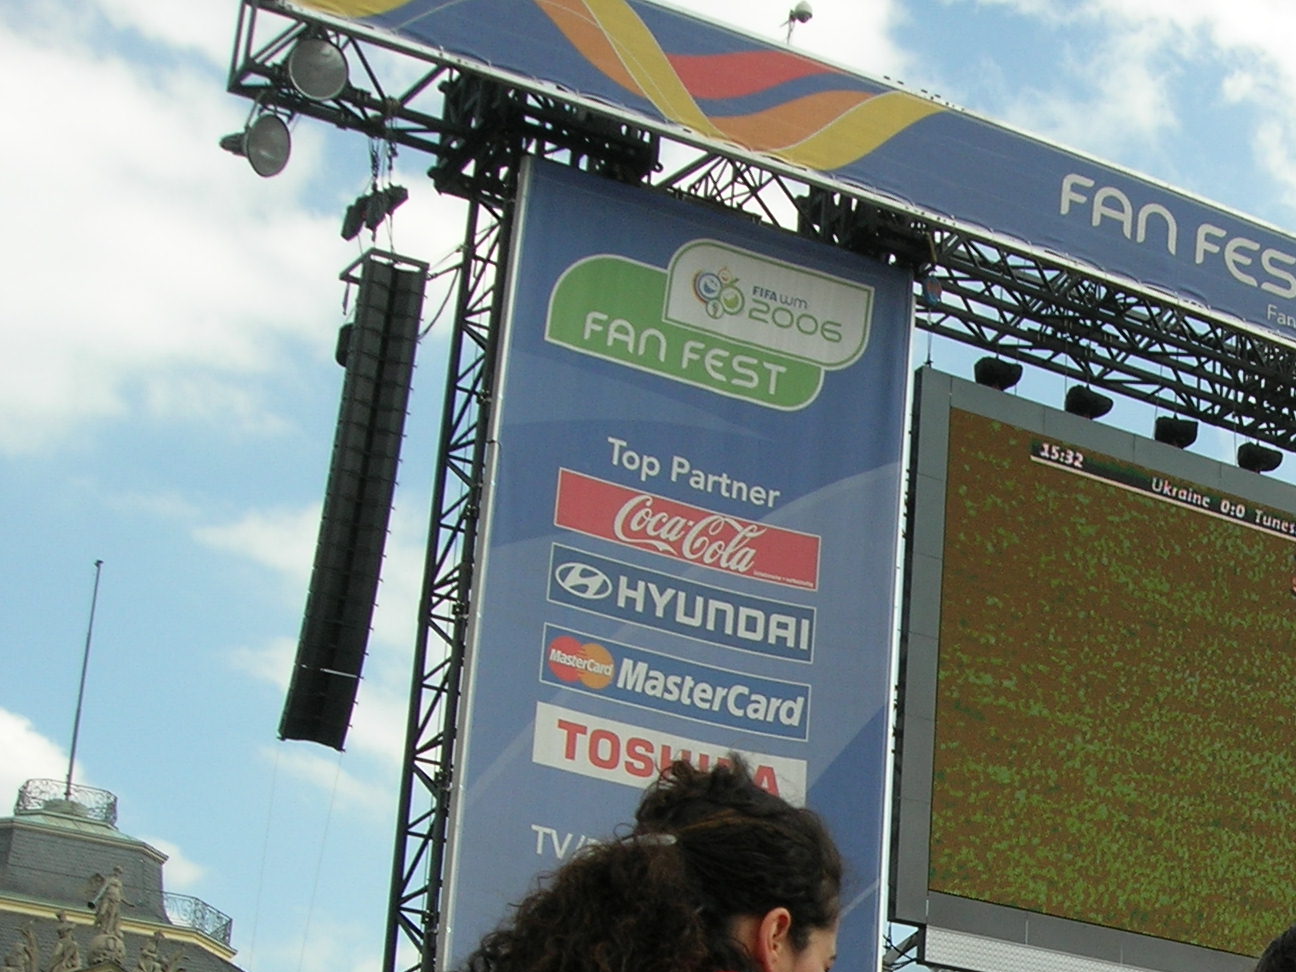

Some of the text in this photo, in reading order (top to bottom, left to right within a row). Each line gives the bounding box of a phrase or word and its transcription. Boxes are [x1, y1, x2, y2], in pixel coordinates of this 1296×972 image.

[1060, 173, 1178, 255] FAN
[748, 298, 842, 343] 2006
[752, 286, 777, 302] FIFA
[1267, 304, 1296, 328] Fan
[584, 311, 787, 395] FAN FEST
[608, 437, 780, 508] Top Partner
[1039, 443, 1084, 468] 15:32
[1151, 477, 1211, 508] Ukraine
[1220, 499, 1246, 518] 0:0
[614, 495, 767, 573] Coca-Cola
[616, 575, 810, 650] HYUNDAI
[549, 648, 805, 727] MasterCard MasterCard
